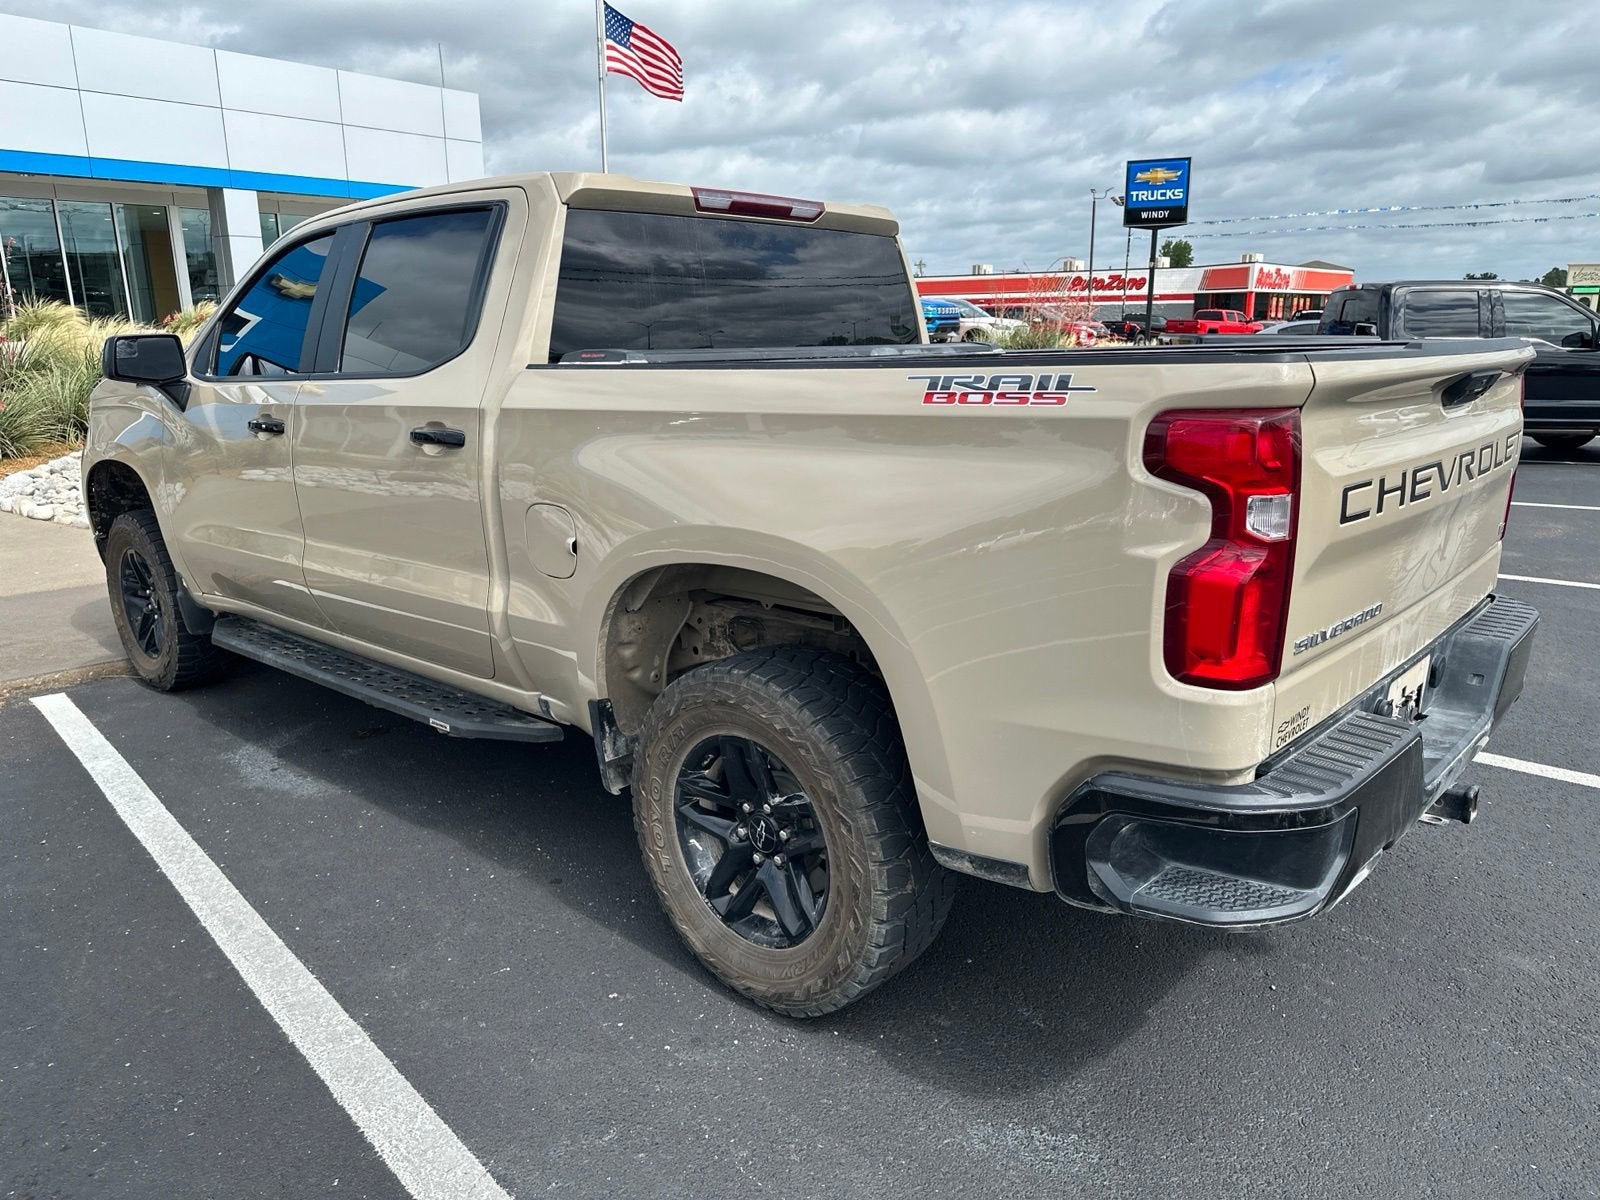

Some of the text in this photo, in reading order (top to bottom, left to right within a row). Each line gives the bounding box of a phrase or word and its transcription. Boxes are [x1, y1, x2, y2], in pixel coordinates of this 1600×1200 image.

[1130, 188, 1184, 202] TRUCKS
[1141, 210, 1170, 219] WINDY
[1067, 274, 1147, 292] AutoZone
[907, 373, 1097, 392] TRAIL
[921, 391, 1070, 406] BOSS
[1339, 428, 1522, 526] CHEVROLET
[1293, 602, 1383, 656] SILVERADO
[1290, 704, 1311, 727] WINDY
[1276, 716, 1310, 748] CHEVROLET
[650, 776, 672, 874] TOYO
